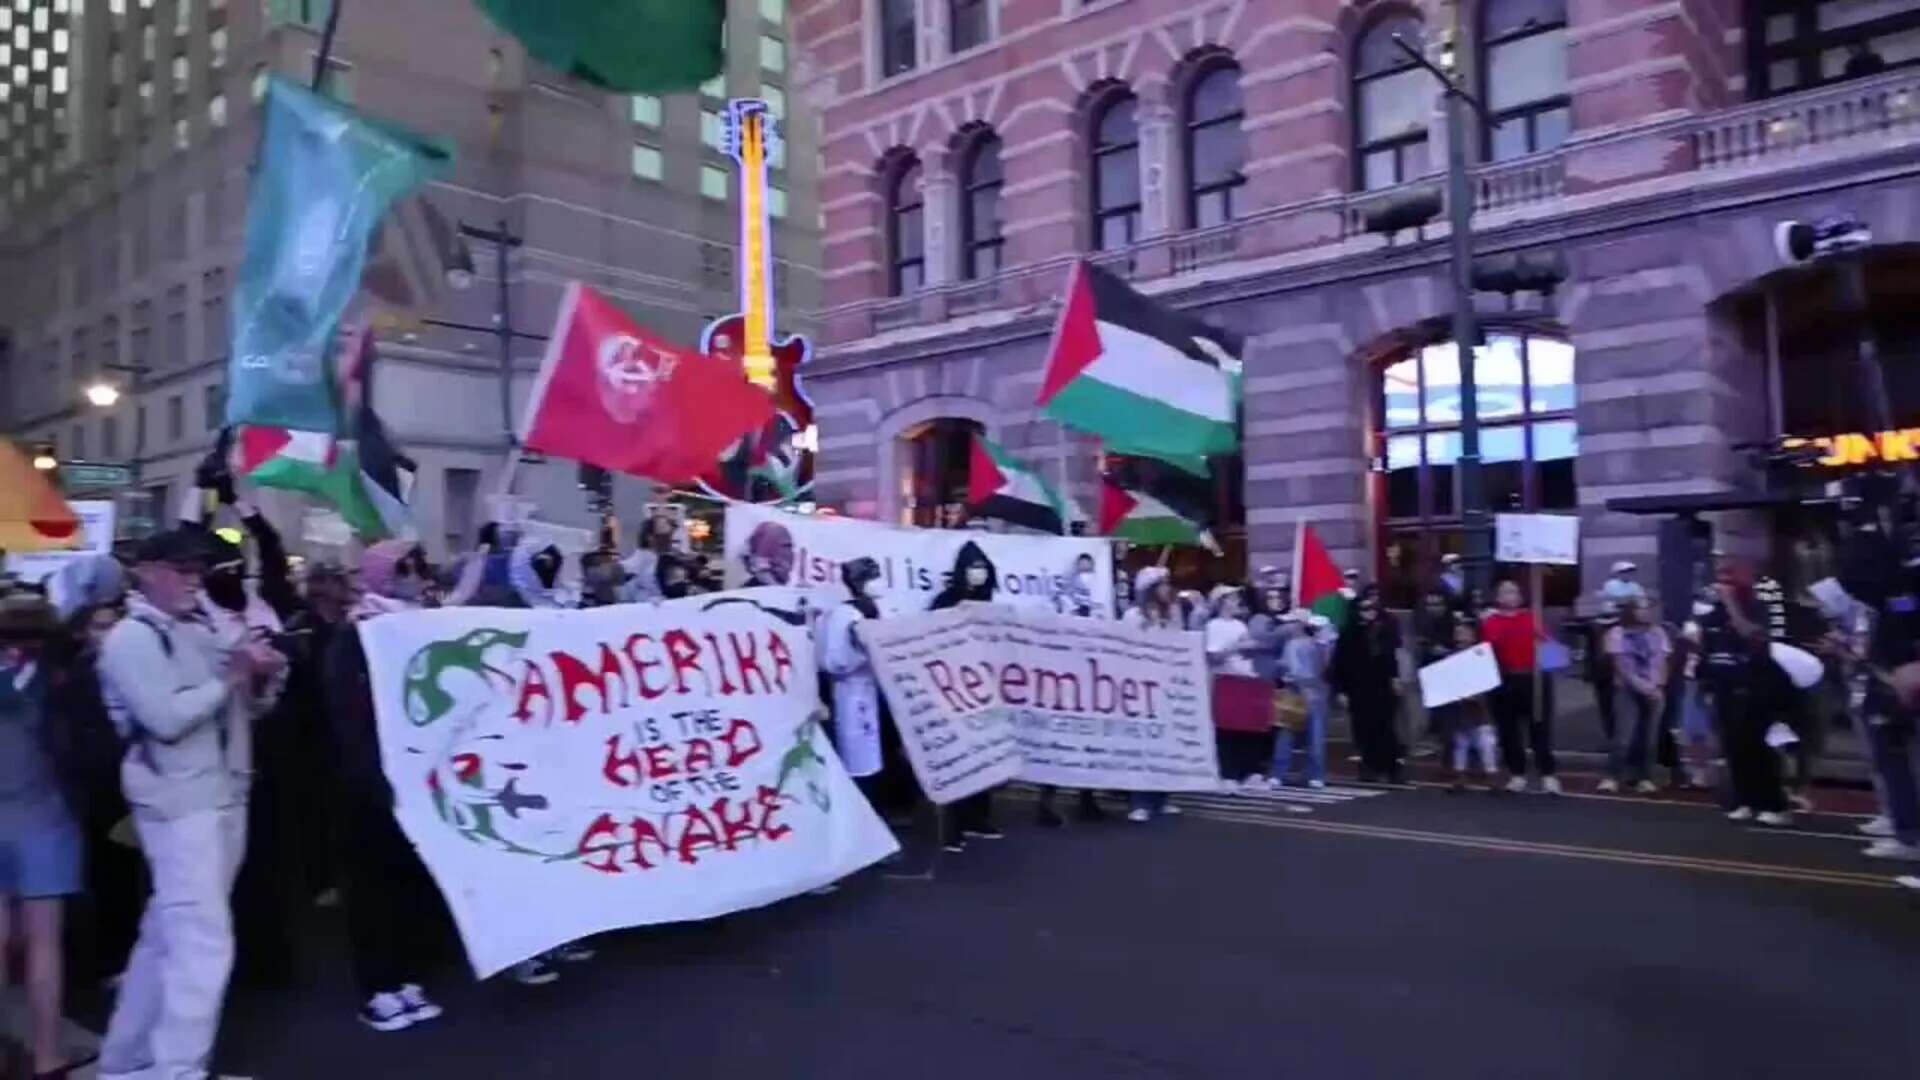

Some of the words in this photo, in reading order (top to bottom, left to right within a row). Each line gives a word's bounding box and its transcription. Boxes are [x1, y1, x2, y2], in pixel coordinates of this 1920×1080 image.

[799, 548, 893, 588] Isrl
[905, 557, 932, 591] is
[507, 628, 793, 728] AMERIKA
[924, 657, 1160, 719] Reember
[603, 718, 763, 788] HEAD
[634, 717, 661, 744] IS
[671, 709, 723, 737] THE
[651, 779, 683, 803] OF
[686, 771, 740, 795] THE
[577, 784, 793, 873] SNAKE
